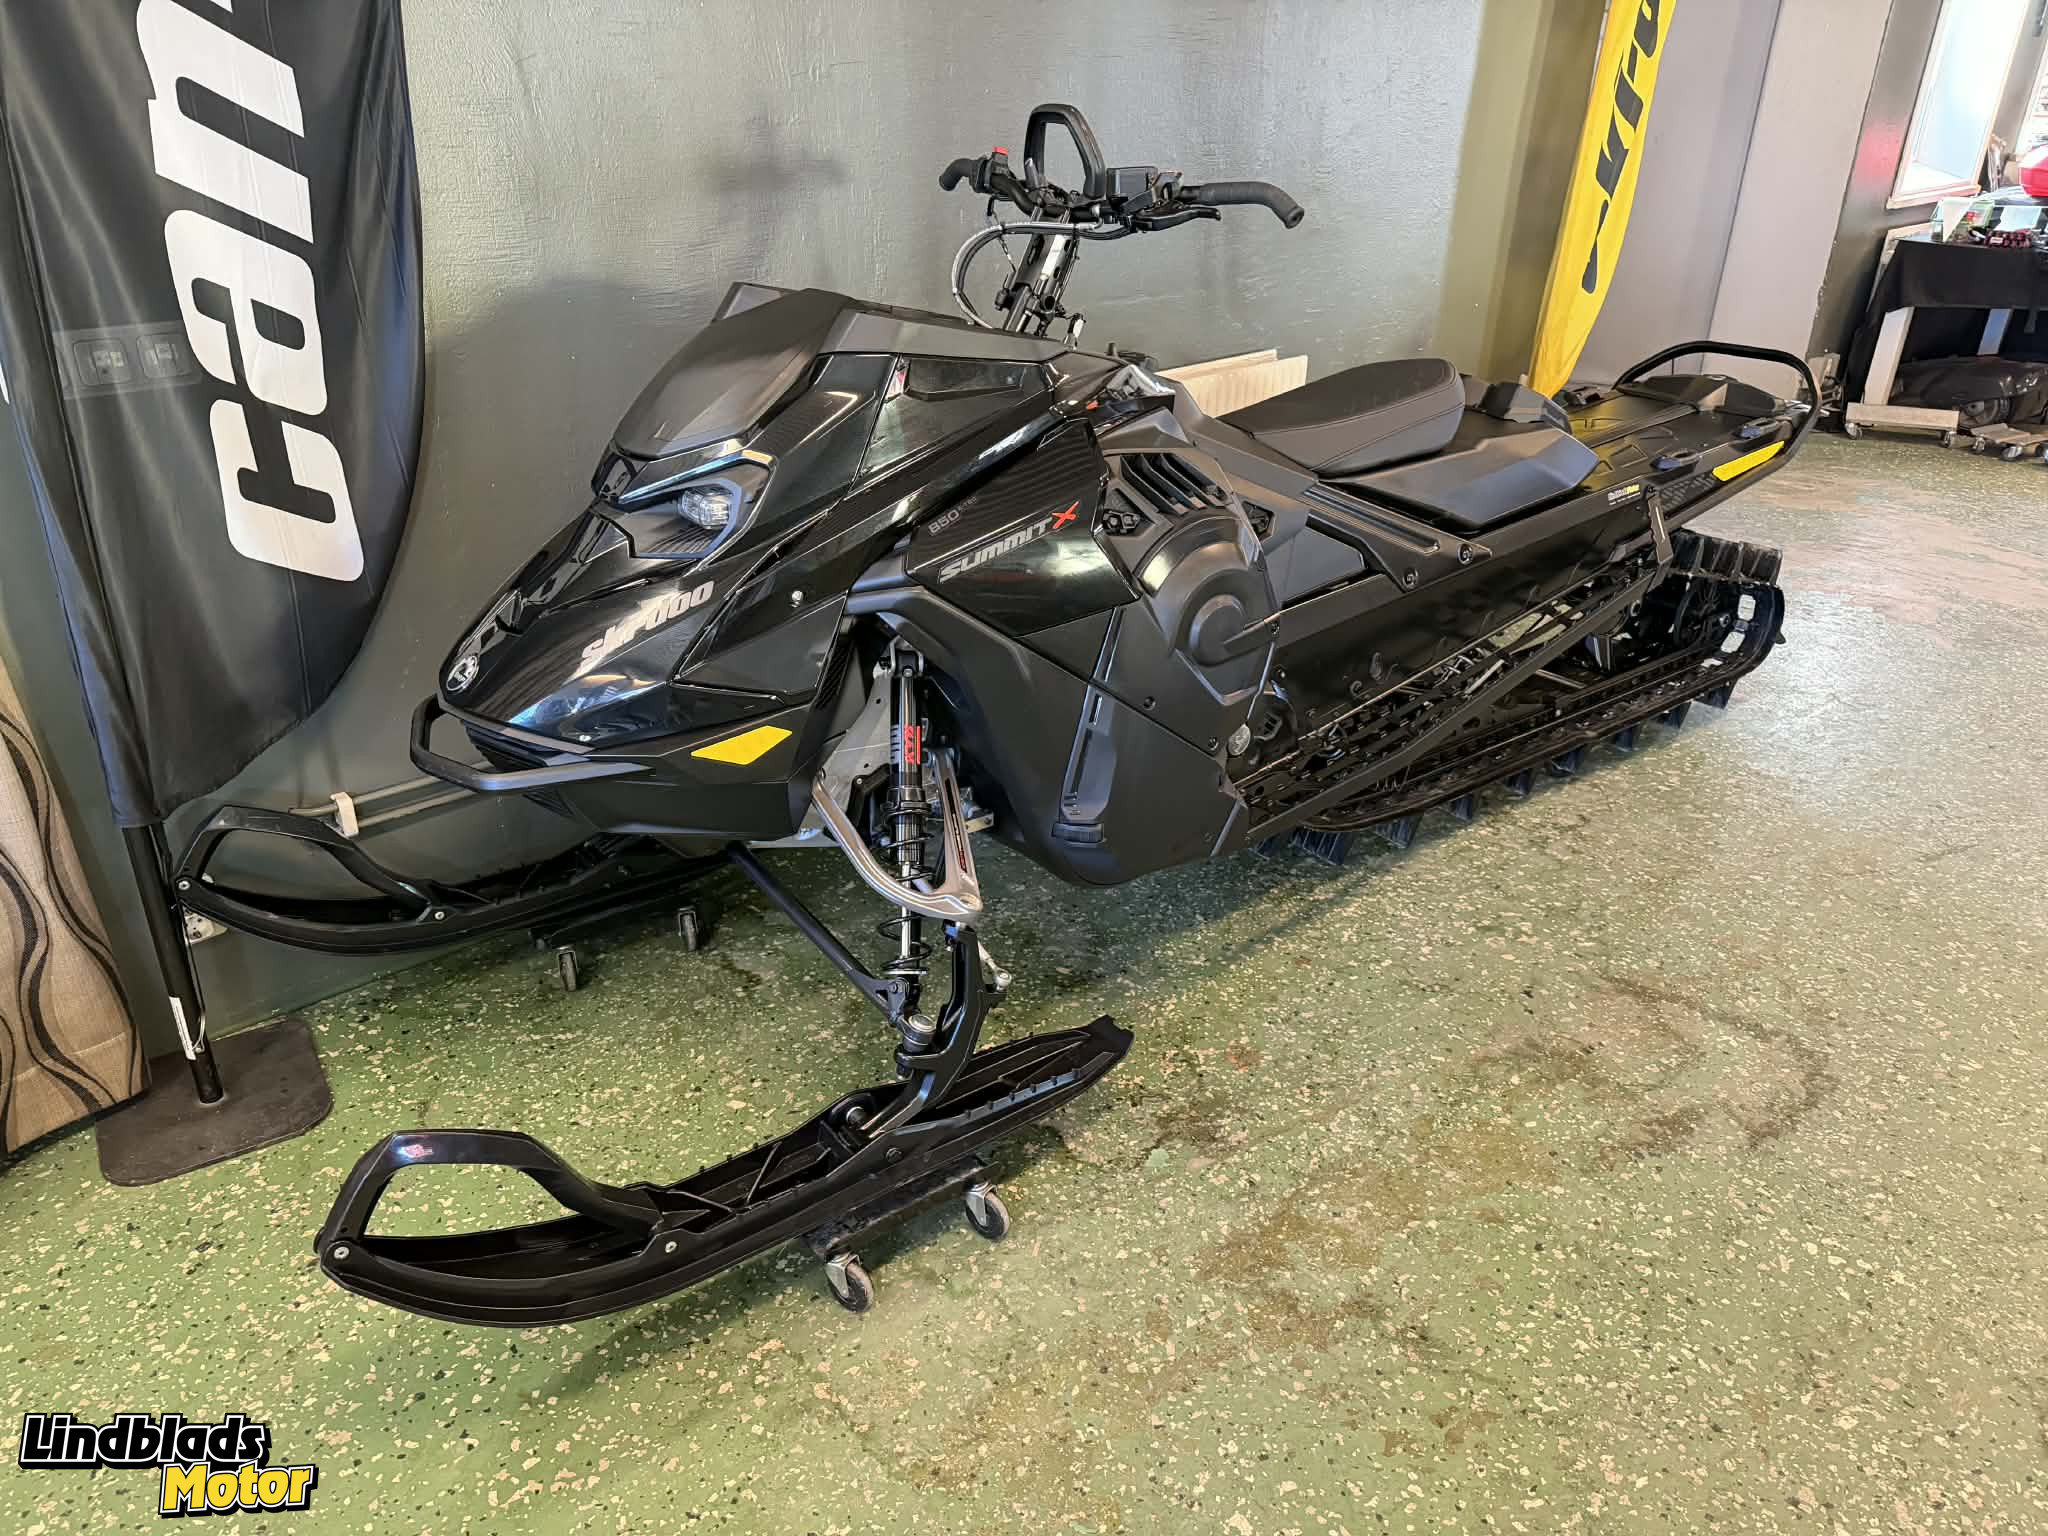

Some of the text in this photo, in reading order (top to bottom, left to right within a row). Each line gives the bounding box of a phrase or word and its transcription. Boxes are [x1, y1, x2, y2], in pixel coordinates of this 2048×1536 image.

[137, 0, 364, 582] can
[928, 508, 960, 534] 850
[1052, 500, 1080, 529] X
